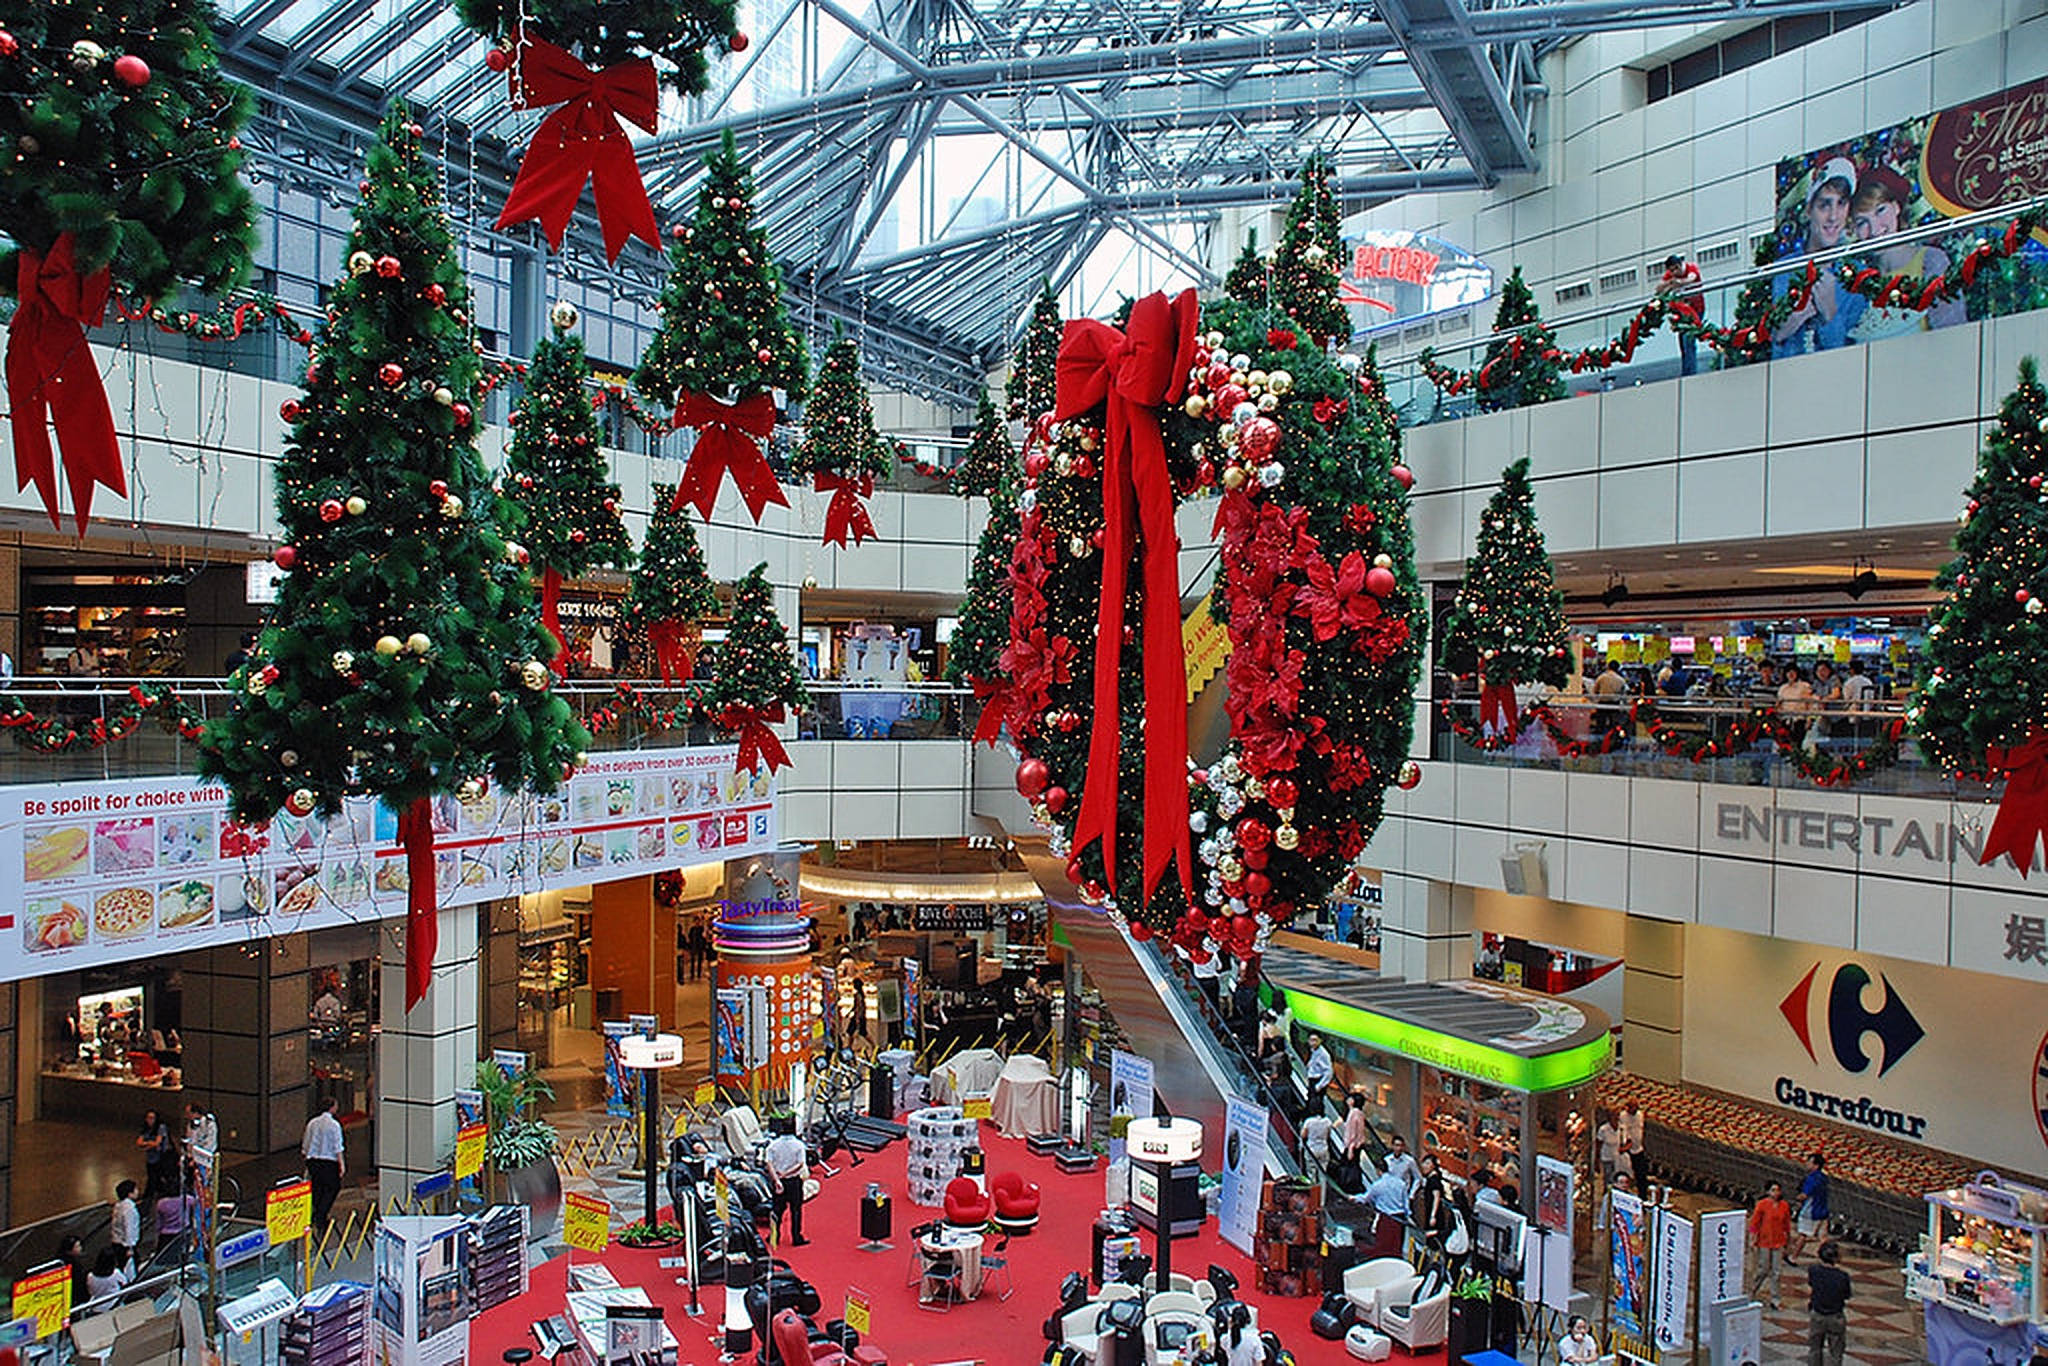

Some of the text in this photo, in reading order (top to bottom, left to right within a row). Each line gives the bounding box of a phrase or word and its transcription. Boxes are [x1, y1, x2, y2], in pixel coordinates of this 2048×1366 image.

[1354, 245, 1440, 286] FACTORY
[24, 786, 224, 816] Be spoilt for choice with
[717, 897, 801, 920] TastyTreat
[1400, 1038, 1504, 1079] CHINESE TEA HOUSE
[1775, 1076, 1926, 1139] Carrefour
[222, 1234, 265, 1259] CASIO
